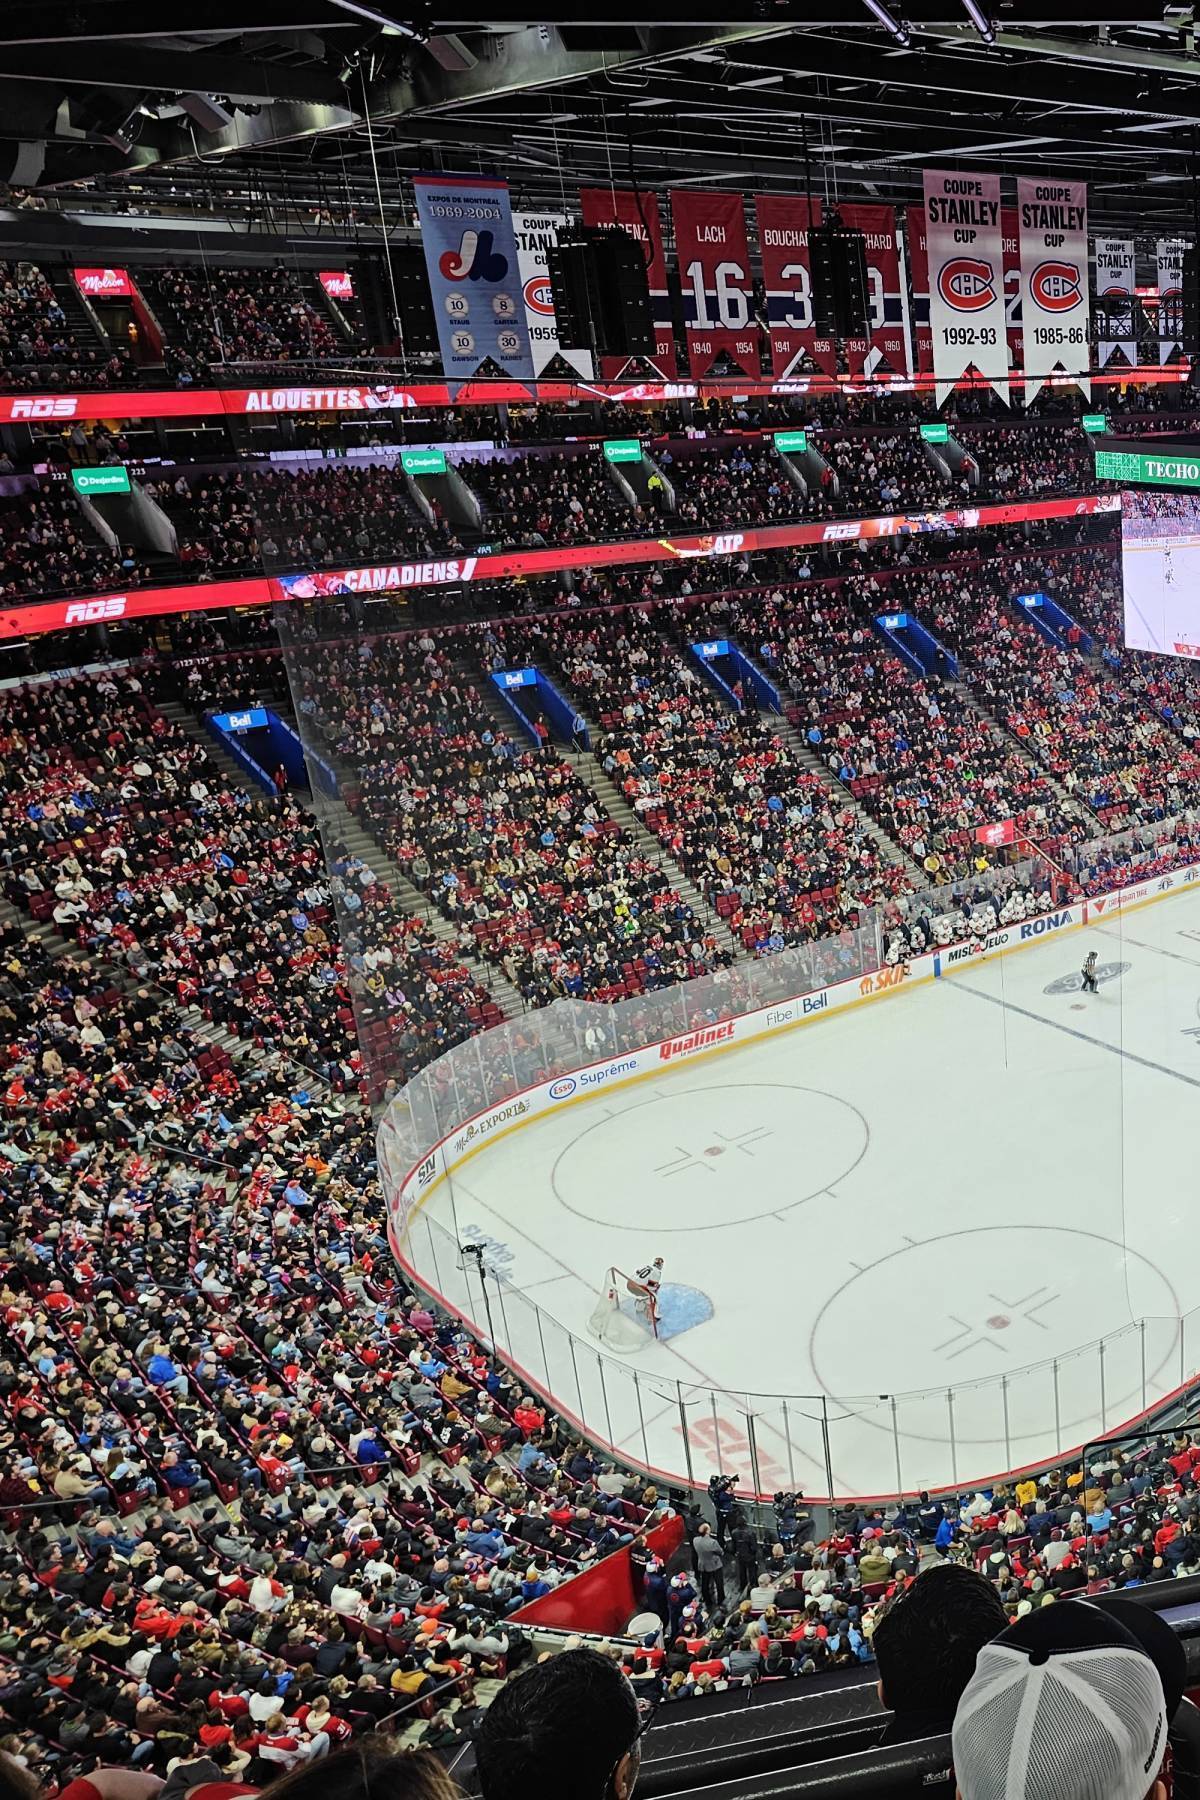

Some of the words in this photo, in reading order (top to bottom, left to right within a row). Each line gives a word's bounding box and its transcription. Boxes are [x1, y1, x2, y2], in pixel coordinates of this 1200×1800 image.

[944, 179, 982, 196] COUPE
[1036, 186, 1071, 202] COUPE
[427, 195, 450, 203] EXPOS
[429, 205, 501, 219] 1969-2004
[928, 197, 998, 226] STANLEY
[1022, 203, 1085, 230] STANLEY
[523, 219, 557, 230] COUPE
[696, 226, 726, 243] LACH
[953, 229, 976, 243] CUP
[1044, 234, 1064, 247] CUP
[1105, 243, 1126, 252] COUPE
[1165, 246, 1184, 254] COUPE
[1097, 253, 1134, 269] STANLEY
[80, 273, 126, 290] Molson
[1110, 270, 1122, 279] CUP
[1169, 272, 1180, 280] CUP
[686, 261, 749, 330] 16
[781, 264, 813, 329] 3
[450, 300, 463, 311] 10
[499, 300, 508, 311] 8
[457, 338, 469, 347] 10
[501, 337, 516, 347] 30
[942, 327, 996, 345] 1992-93
[1033, 327, 1083, 344] 1985-86
[692, 342, 712, 354] 1940
[735, 342, 753, 353] 1954
[774, 341, 790, 352] 1941
[813, 341, 830, 352] 1956
[850, 341, 866, 352] 1942
[884, 341, 900, 351] 1960
[246, 388, 362, 412] ALOUETTES
[89, 475, 124, 485] Desjardins
[878, 518, 894, 534] F1
[714, 535, 744, 551] ATP
[344, 562, 459, 591] CANADIENS
[702, 643, 718, 655] Bell
[505, 672, 524, 685] Bell
[229, 713, 252, 726] Bell
[1136, 888, 1148, 900] TIRE
[1020, 910, 1073, 940] RONA
[766, 1008, 793, 1027] Fibe
[802, 992, 828, 1014] Bell
[659, 1021, 736, 1061] Qualinet
[553, 1082, 574, 1096] Esso
[580, 1060, 637, 1086] Suprême
[480, 1102, 520, 1133] EXPORT
[418, 1153, 436, 1183] SN
